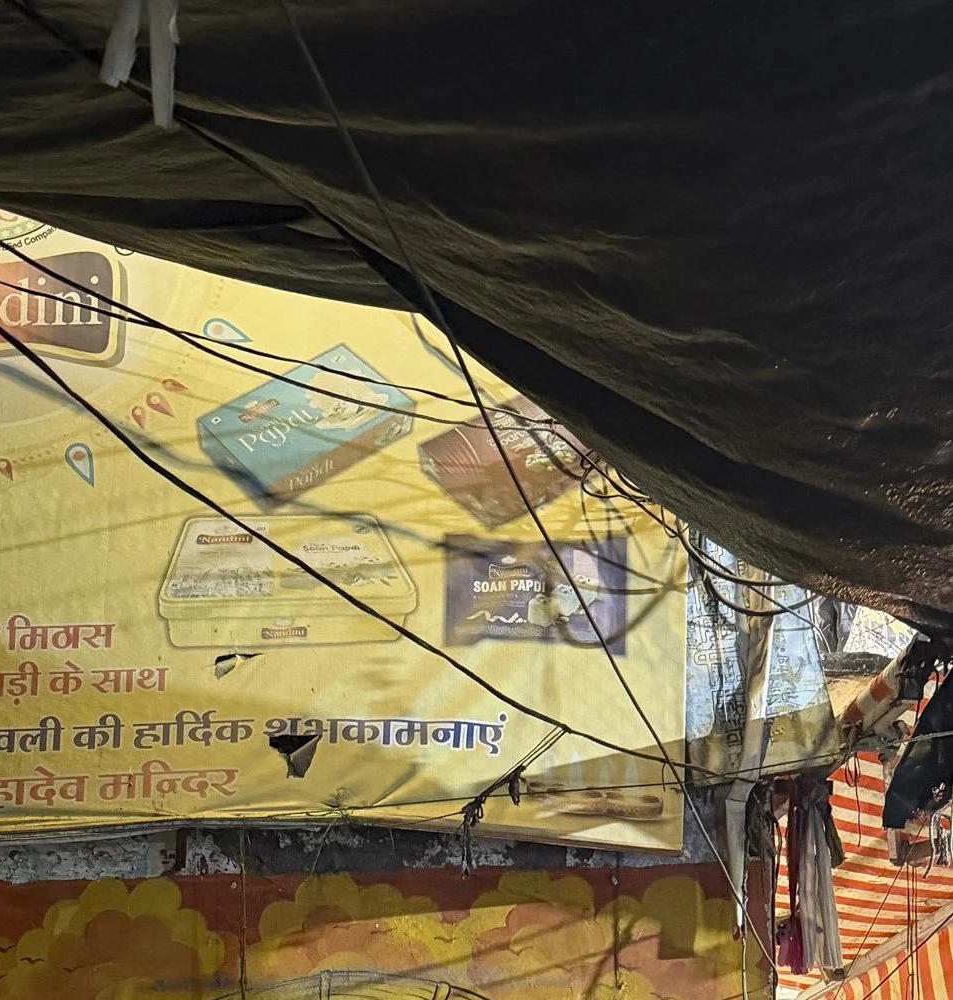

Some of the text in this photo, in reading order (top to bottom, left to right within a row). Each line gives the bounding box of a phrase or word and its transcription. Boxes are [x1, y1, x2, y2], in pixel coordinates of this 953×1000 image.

[24, 226, 58, 246] Compan
[473, 579, 546, 593] SOAN PAPDI
[6, 614, 115, 651] मिठास
[49, 660, 83, 696] के
[91, 667, 169, 695] साथ
[73, 713, 124, 751] की
[133, 709, 254, 749] हार्दिक
[264, 713, 508, 755] शभकामनाएं
[99, 759, 238, 799] मन्दिर
